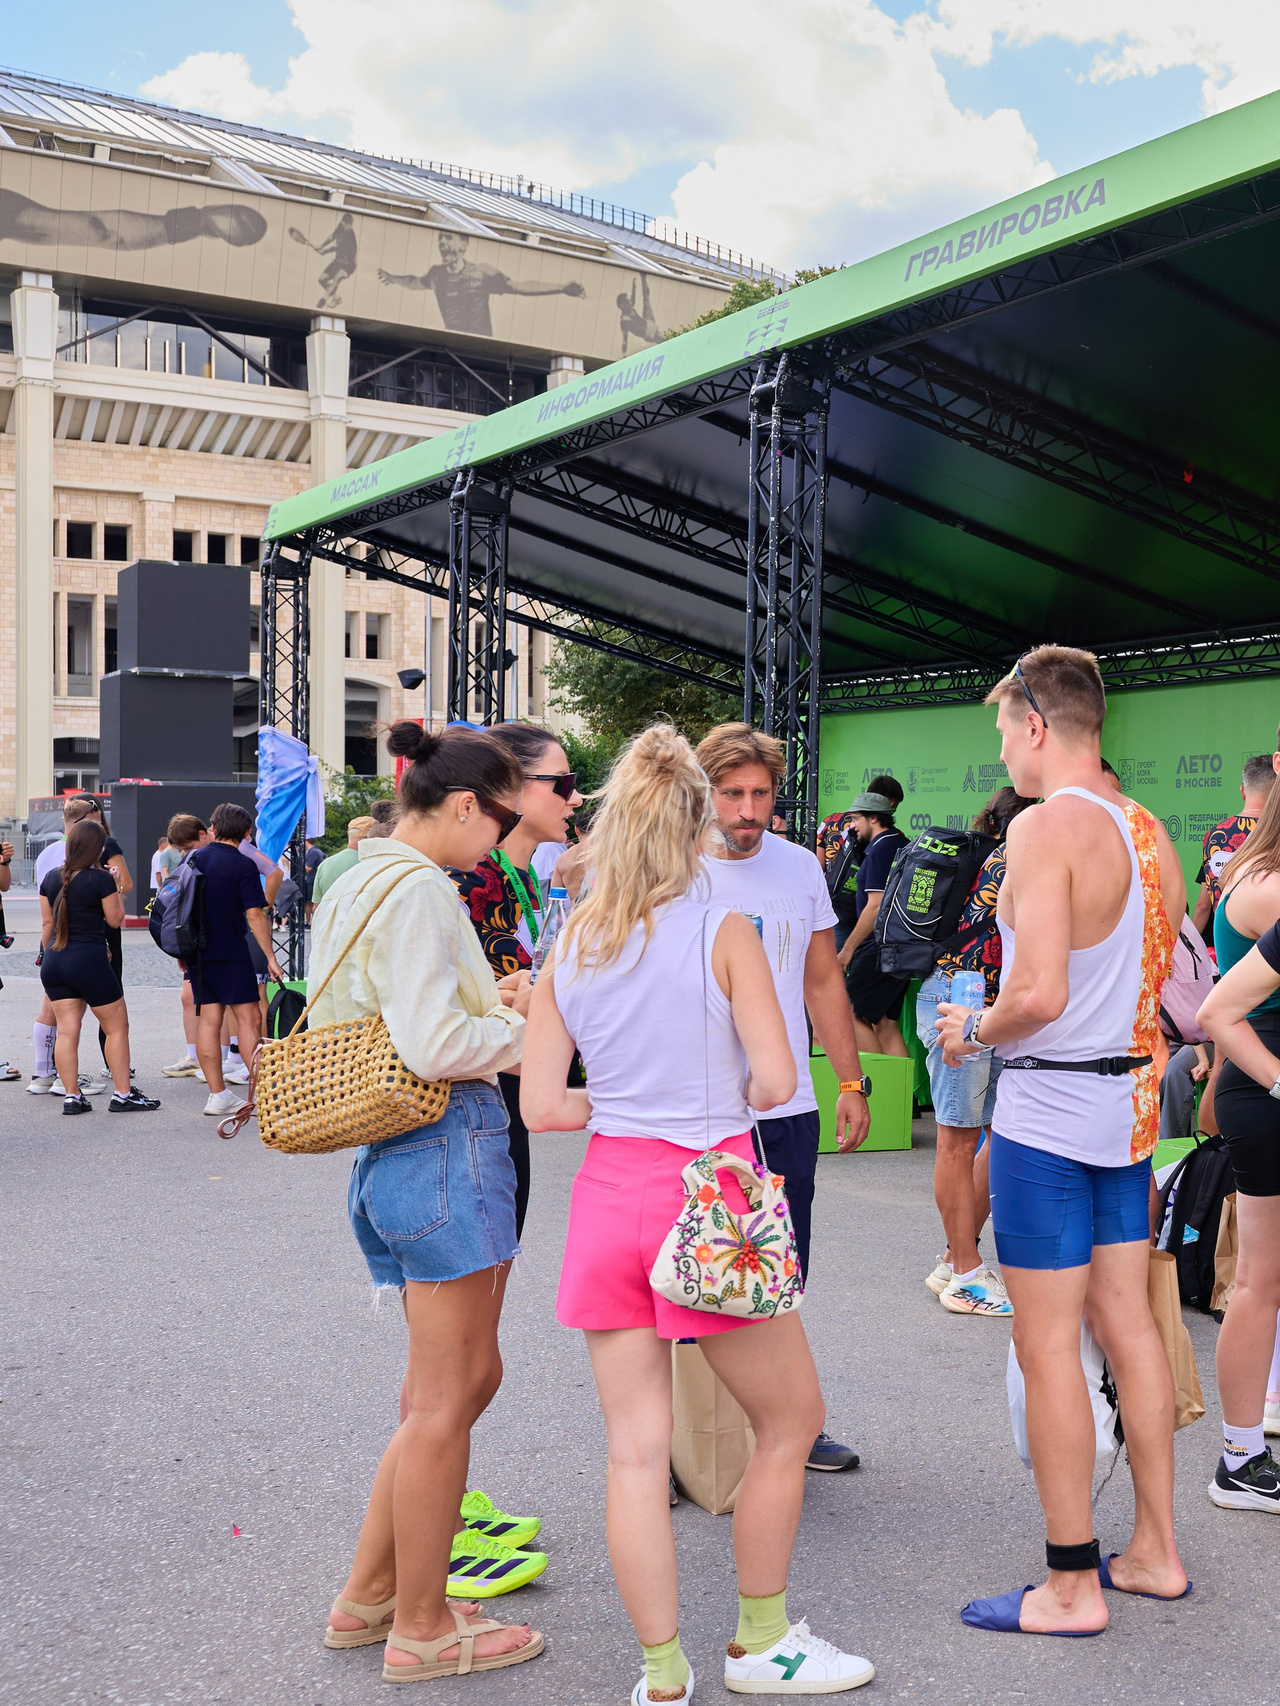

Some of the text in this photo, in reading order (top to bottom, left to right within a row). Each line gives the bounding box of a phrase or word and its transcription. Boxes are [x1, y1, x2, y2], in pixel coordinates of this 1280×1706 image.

[904, 178, 1106, 283] ГРАВИРОВКА
[537, 354, 665, 423] ИНФОРМАЦИЯ
[330, 469, 382, 504] МАССАЖ
[979, 763, 1009, 778] МОСКОВС
[1176, 753, 1223, 774] ЛЕТО
[1176, 777, 1222, 788] В МОСКВЕ
[1188, 814, 1228, 822] ФЕДЕРАЦИЯ
[1188, 823, 1218, 832] ТРИАТЛО
[1188, 833, 1206, 842] РОСС
